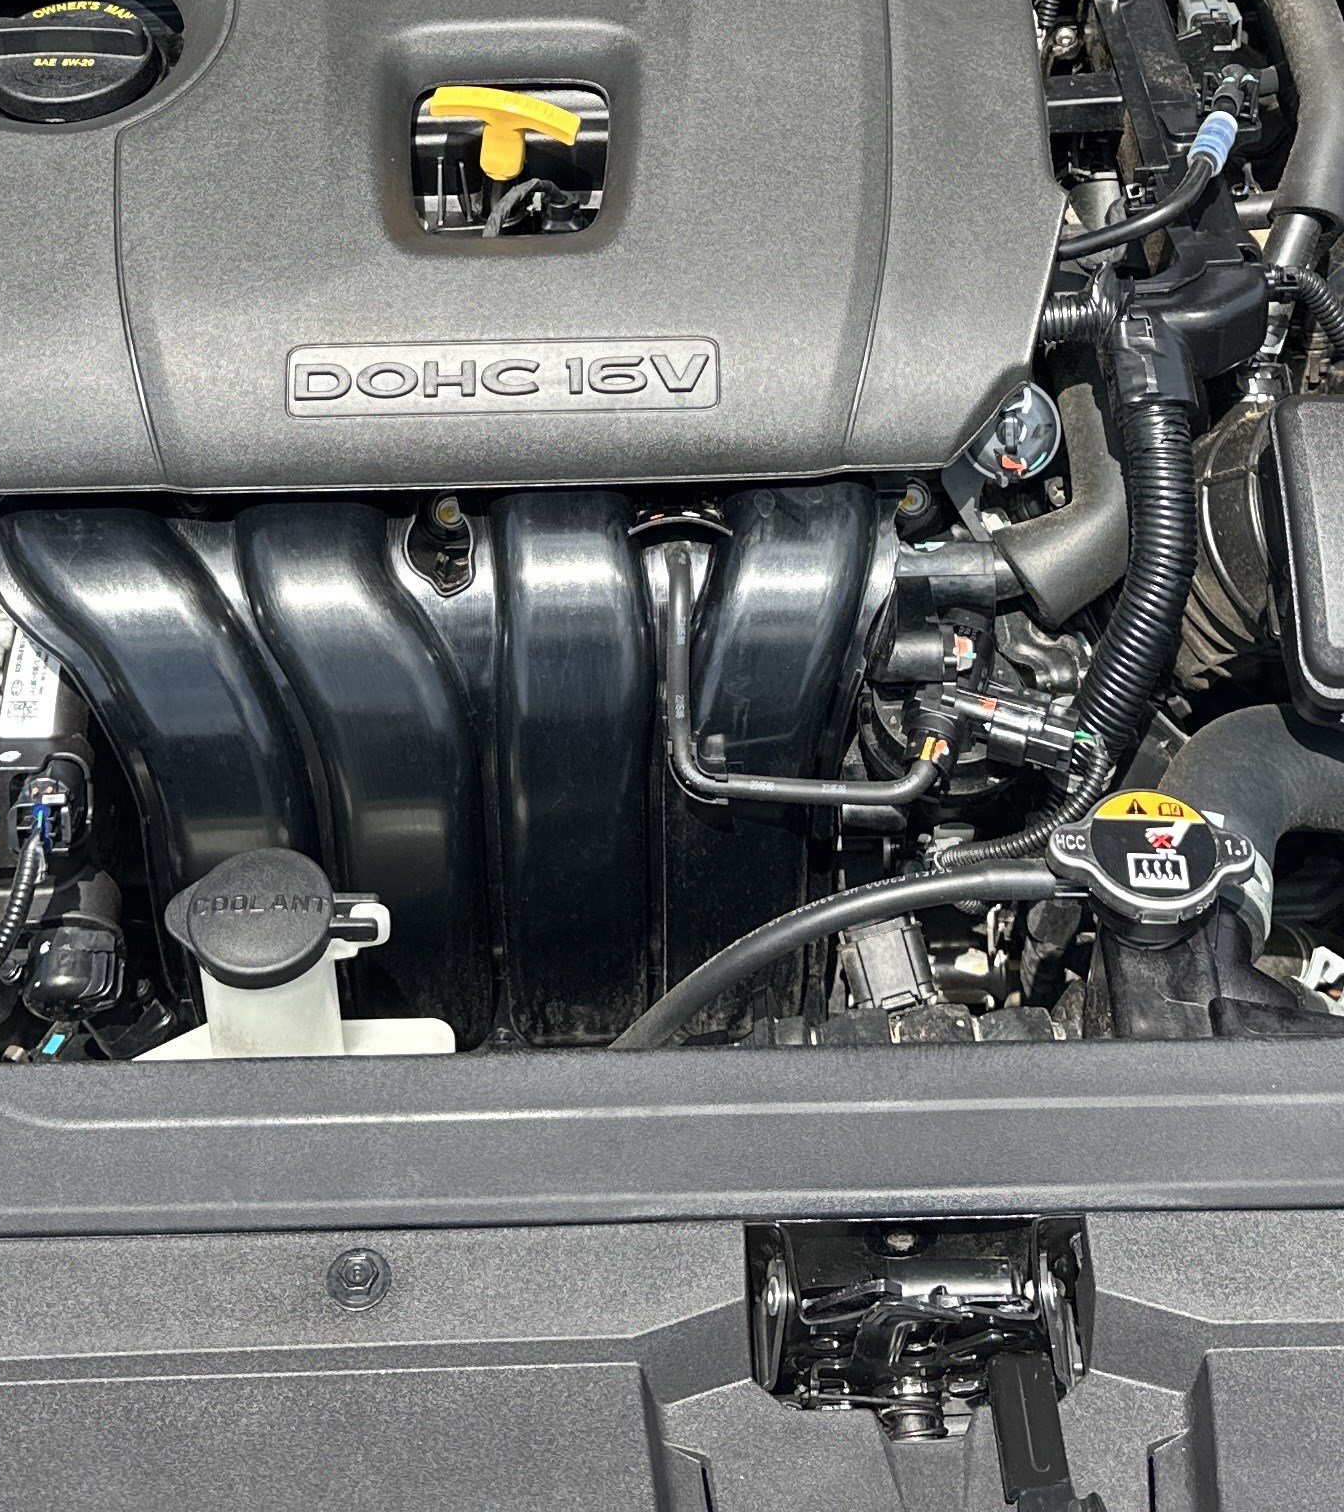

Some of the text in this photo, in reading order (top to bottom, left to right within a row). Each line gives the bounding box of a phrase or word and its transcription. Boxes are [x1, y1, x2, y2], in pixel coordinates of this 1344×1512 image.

[32, 0, 135, 19] OWNER'S MAN
[33, 58, 95, 67] SAE 5W-20
[292, 352, 709, 402] DOHC 16V
[1055, 834, 1087, 850] HCC
[1224, 839, 1248, 856] 1.1
[192, 893, 329, 916] COOLANT
